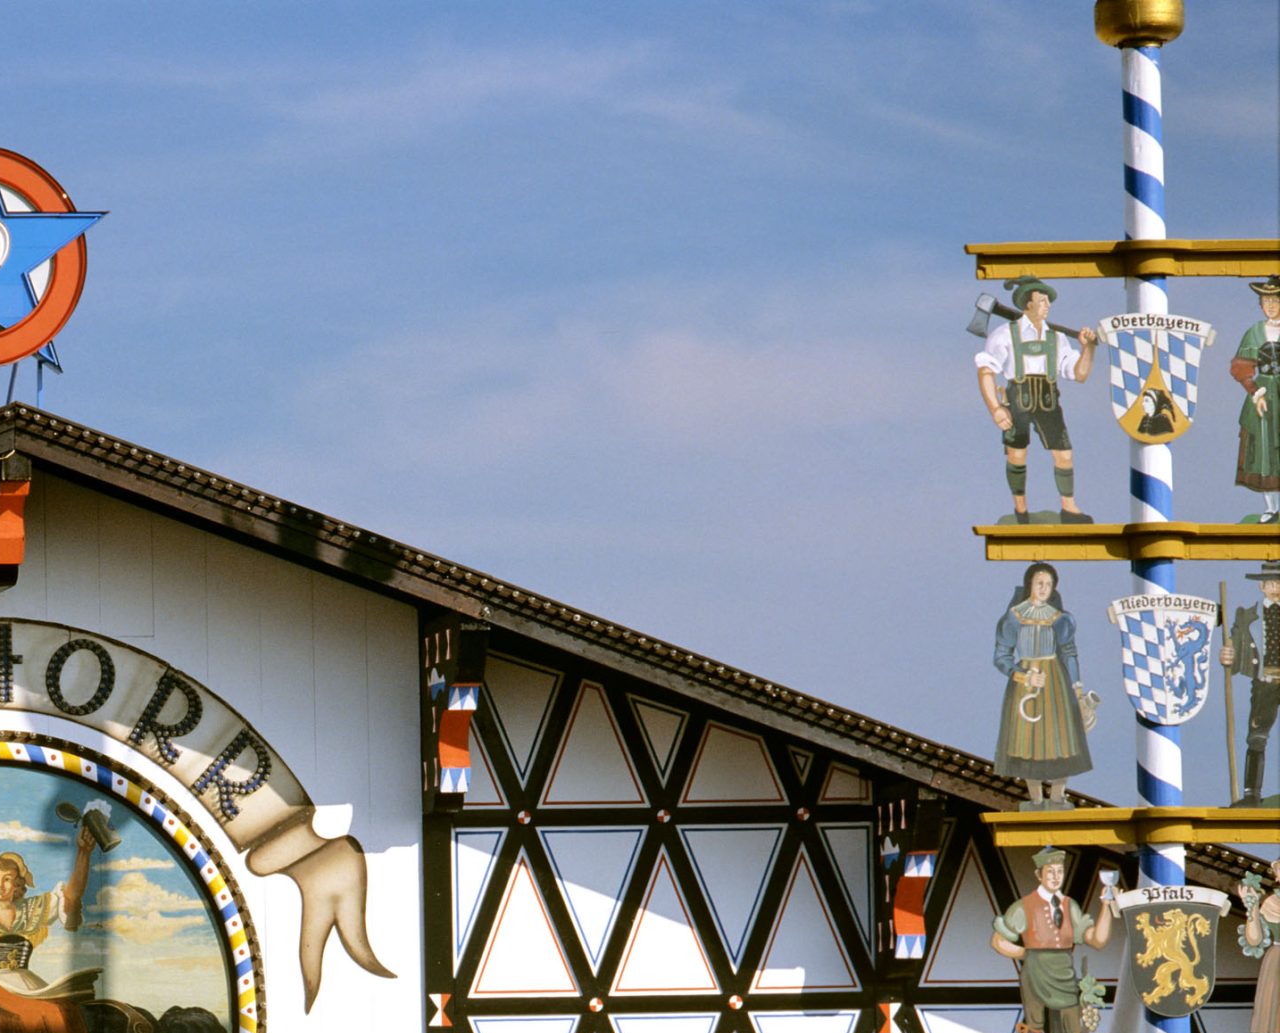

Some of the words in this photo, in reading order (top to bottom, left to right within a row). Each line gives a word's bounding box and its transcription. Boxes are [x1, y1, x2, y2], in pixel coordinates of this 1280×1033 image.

[1110, 314, 1201, 332] Oberbayern
[1119, 595, 1216, 613] Niederbayern
[1142, 887, 1194, 901] Pfalz
